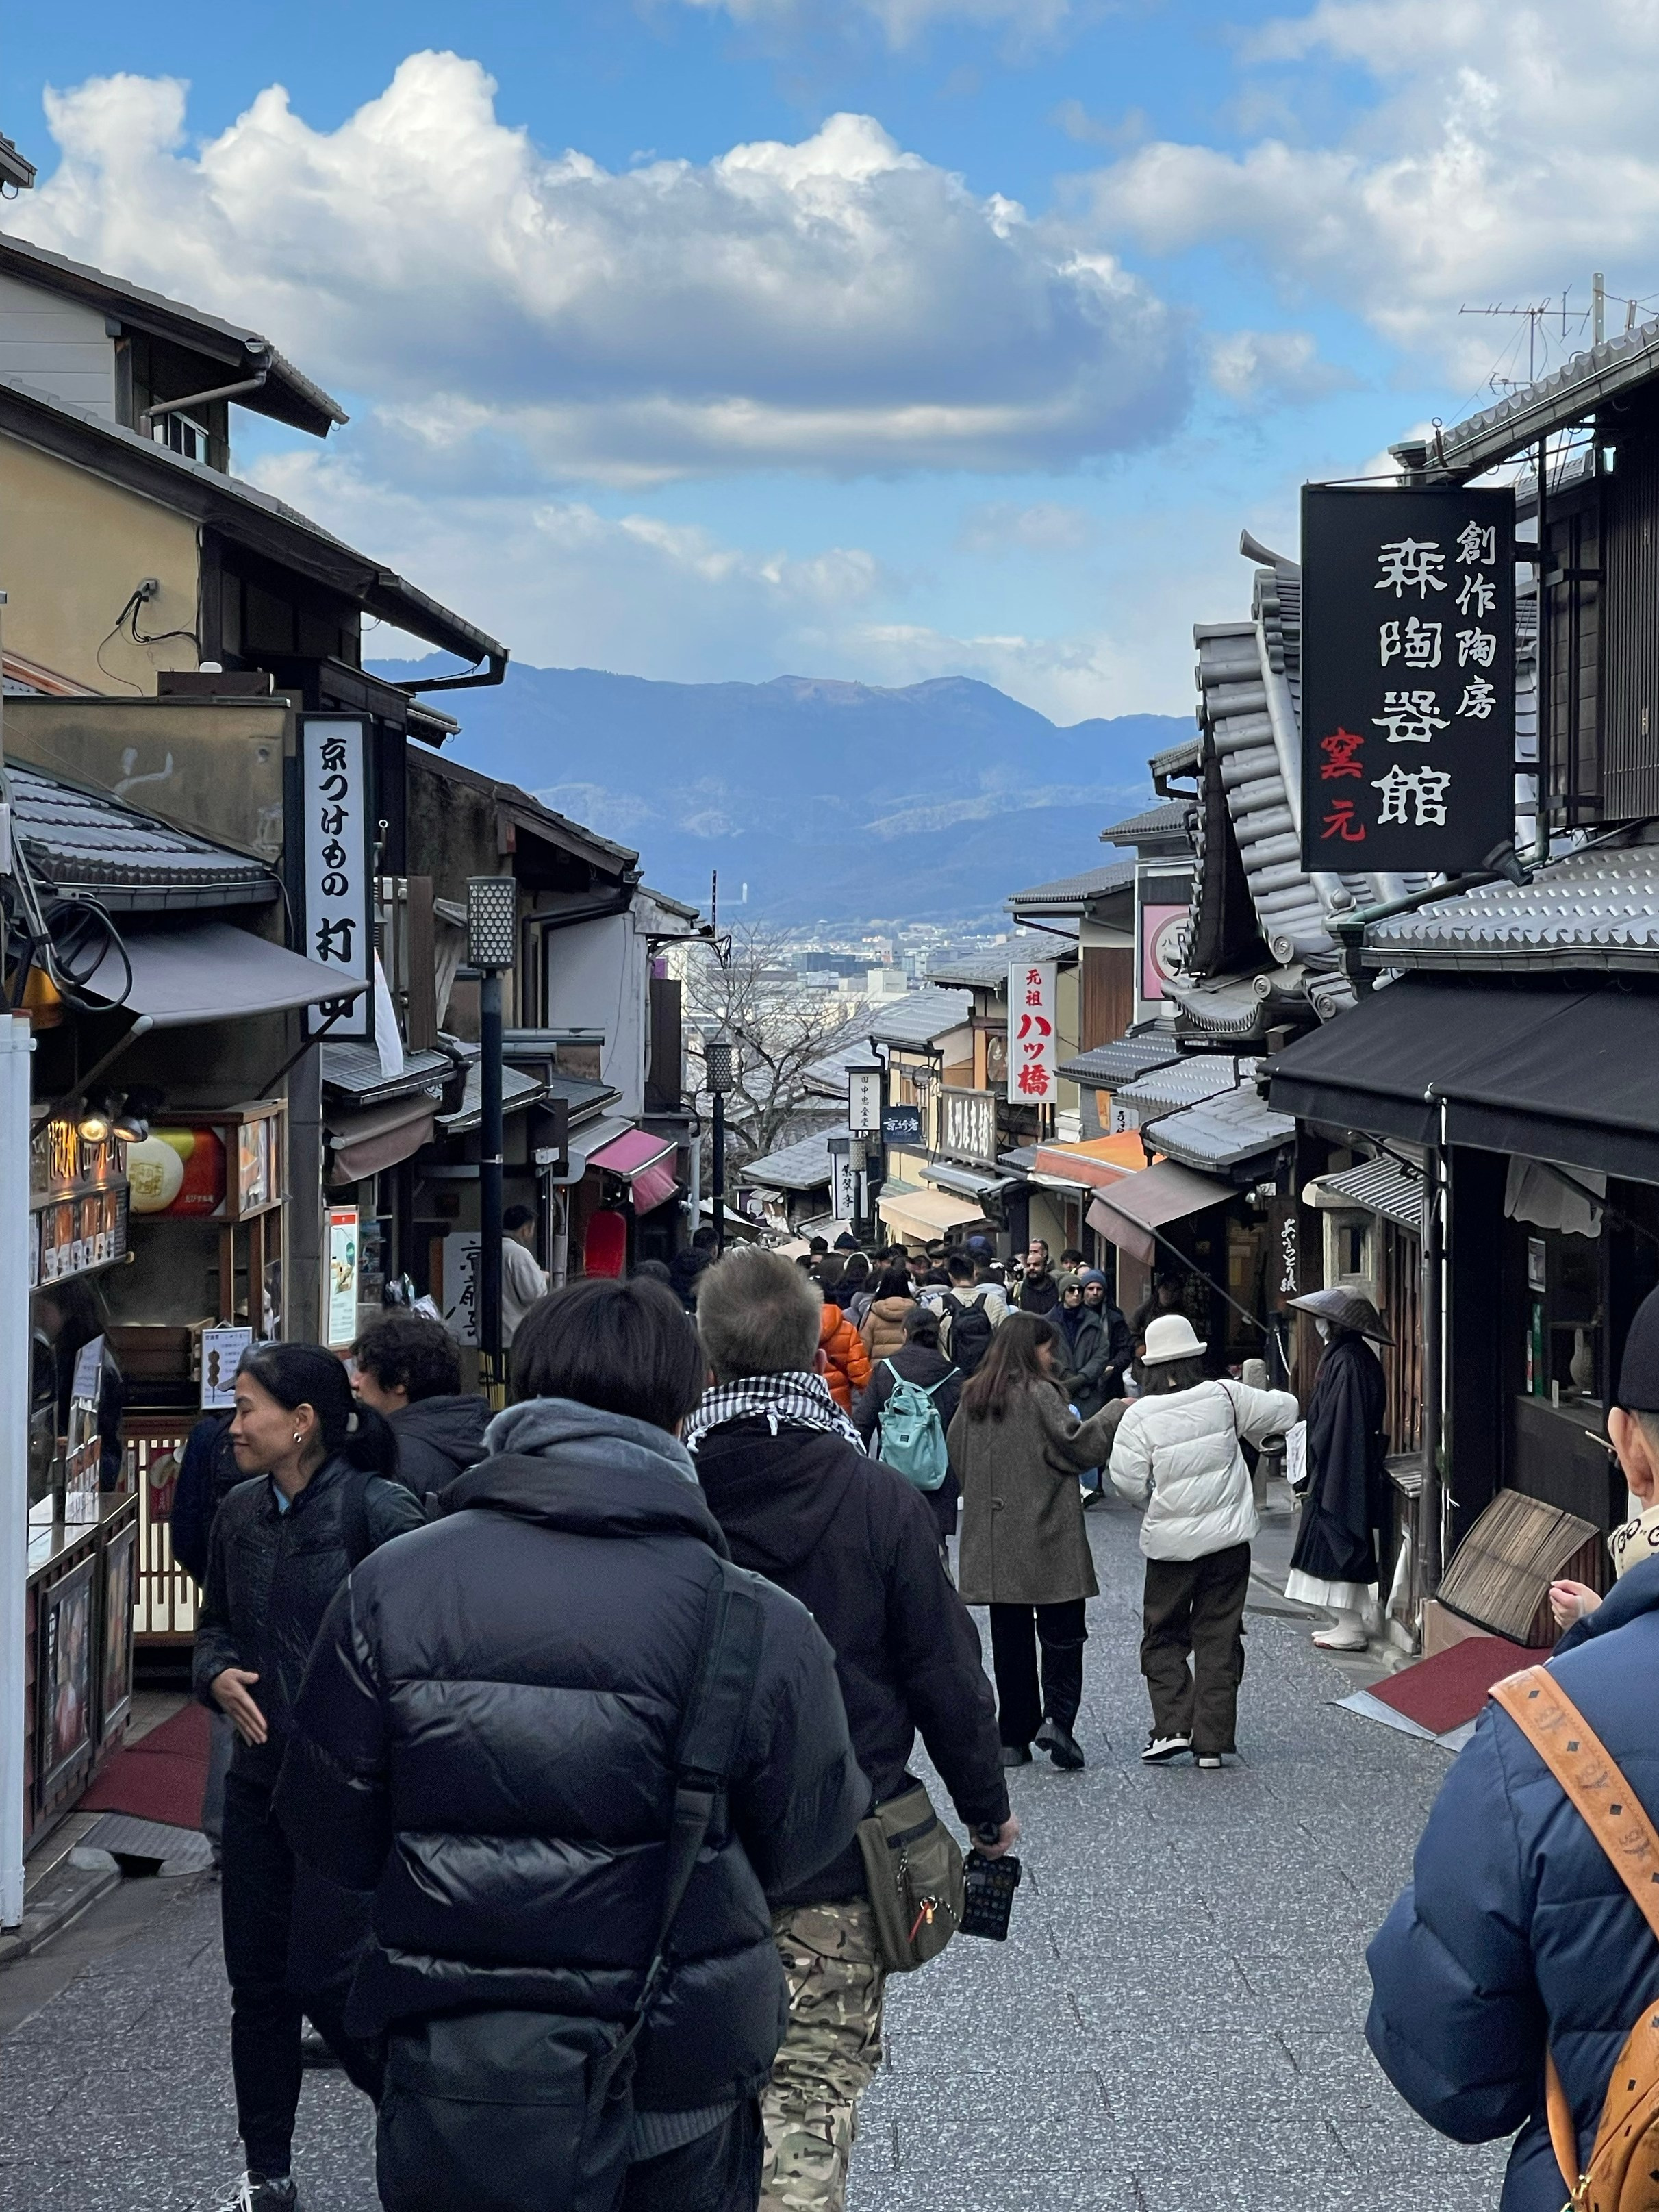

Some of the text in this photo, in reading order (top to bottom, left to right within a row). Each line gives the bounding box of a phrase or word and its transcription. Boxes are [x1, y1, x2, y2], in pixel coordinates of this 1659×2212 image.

[1371, 538, 1451, 827] 森陶器館
[1455, 520, 1497, 720] 創作陶房
[318, 737, 350, 897] 京つけもの
[1320, 727, 1367, 842] 窯元
